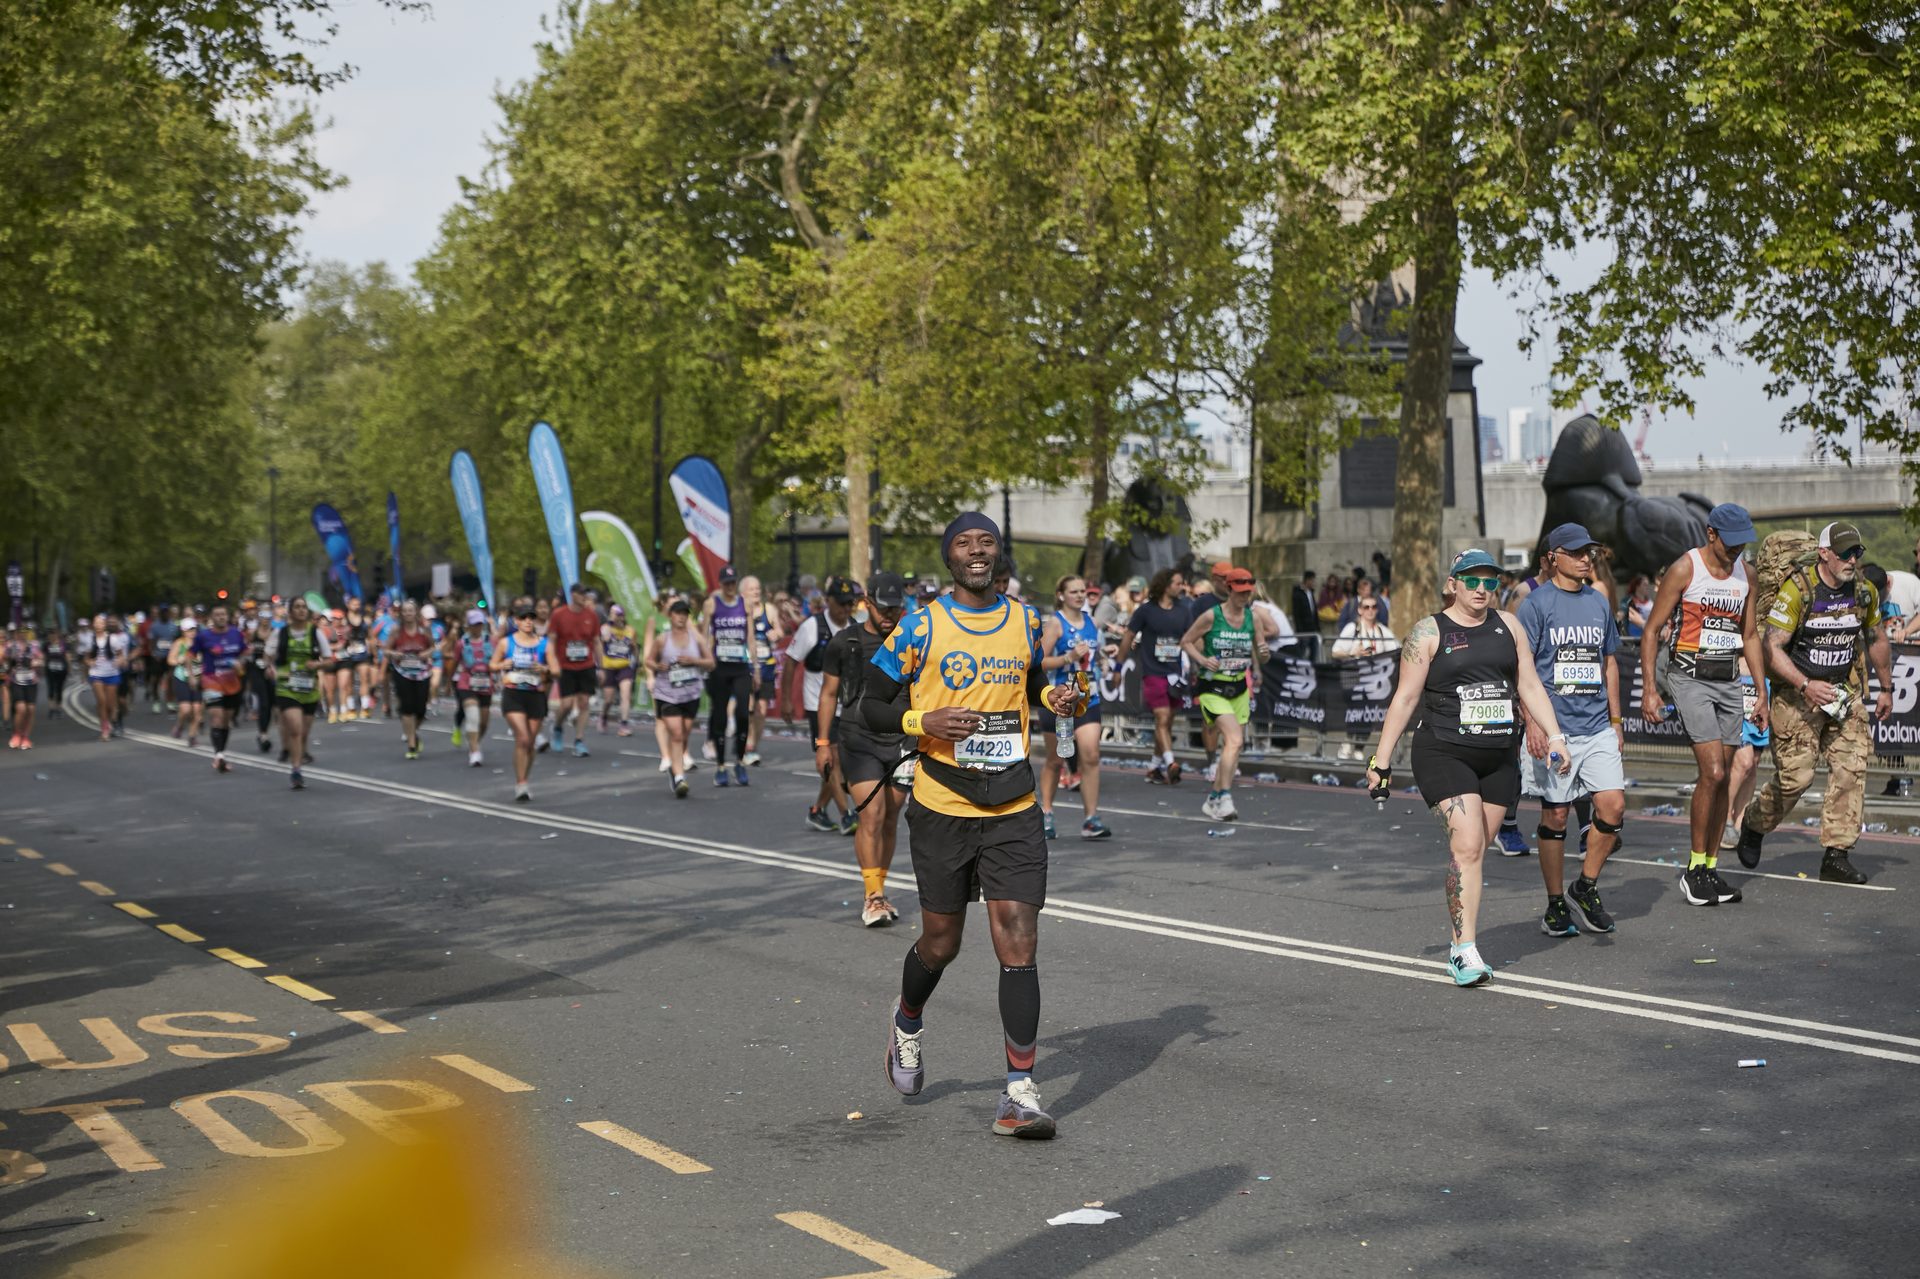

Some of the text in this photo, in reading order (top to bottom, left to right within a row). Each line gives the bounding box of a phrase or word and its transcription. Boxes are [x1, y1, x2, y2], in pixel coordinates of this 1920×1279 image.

[1706, 633, 1737, 649] 64886
[981, 656, 1025, 671] Marie
[980, 671, 1021, 685] Curie
[1562, 667, 1595, 680] 69538
[1345, 705, 1388, 723] new bala
[1468, 705, 1506, 719] 79086
[1644, 719, 1685, 735] balanc
[1878, 720, 1920, 743] balan
[965, 739, 1013, 757] 44229
[0, 1011, 291, 1070] US
